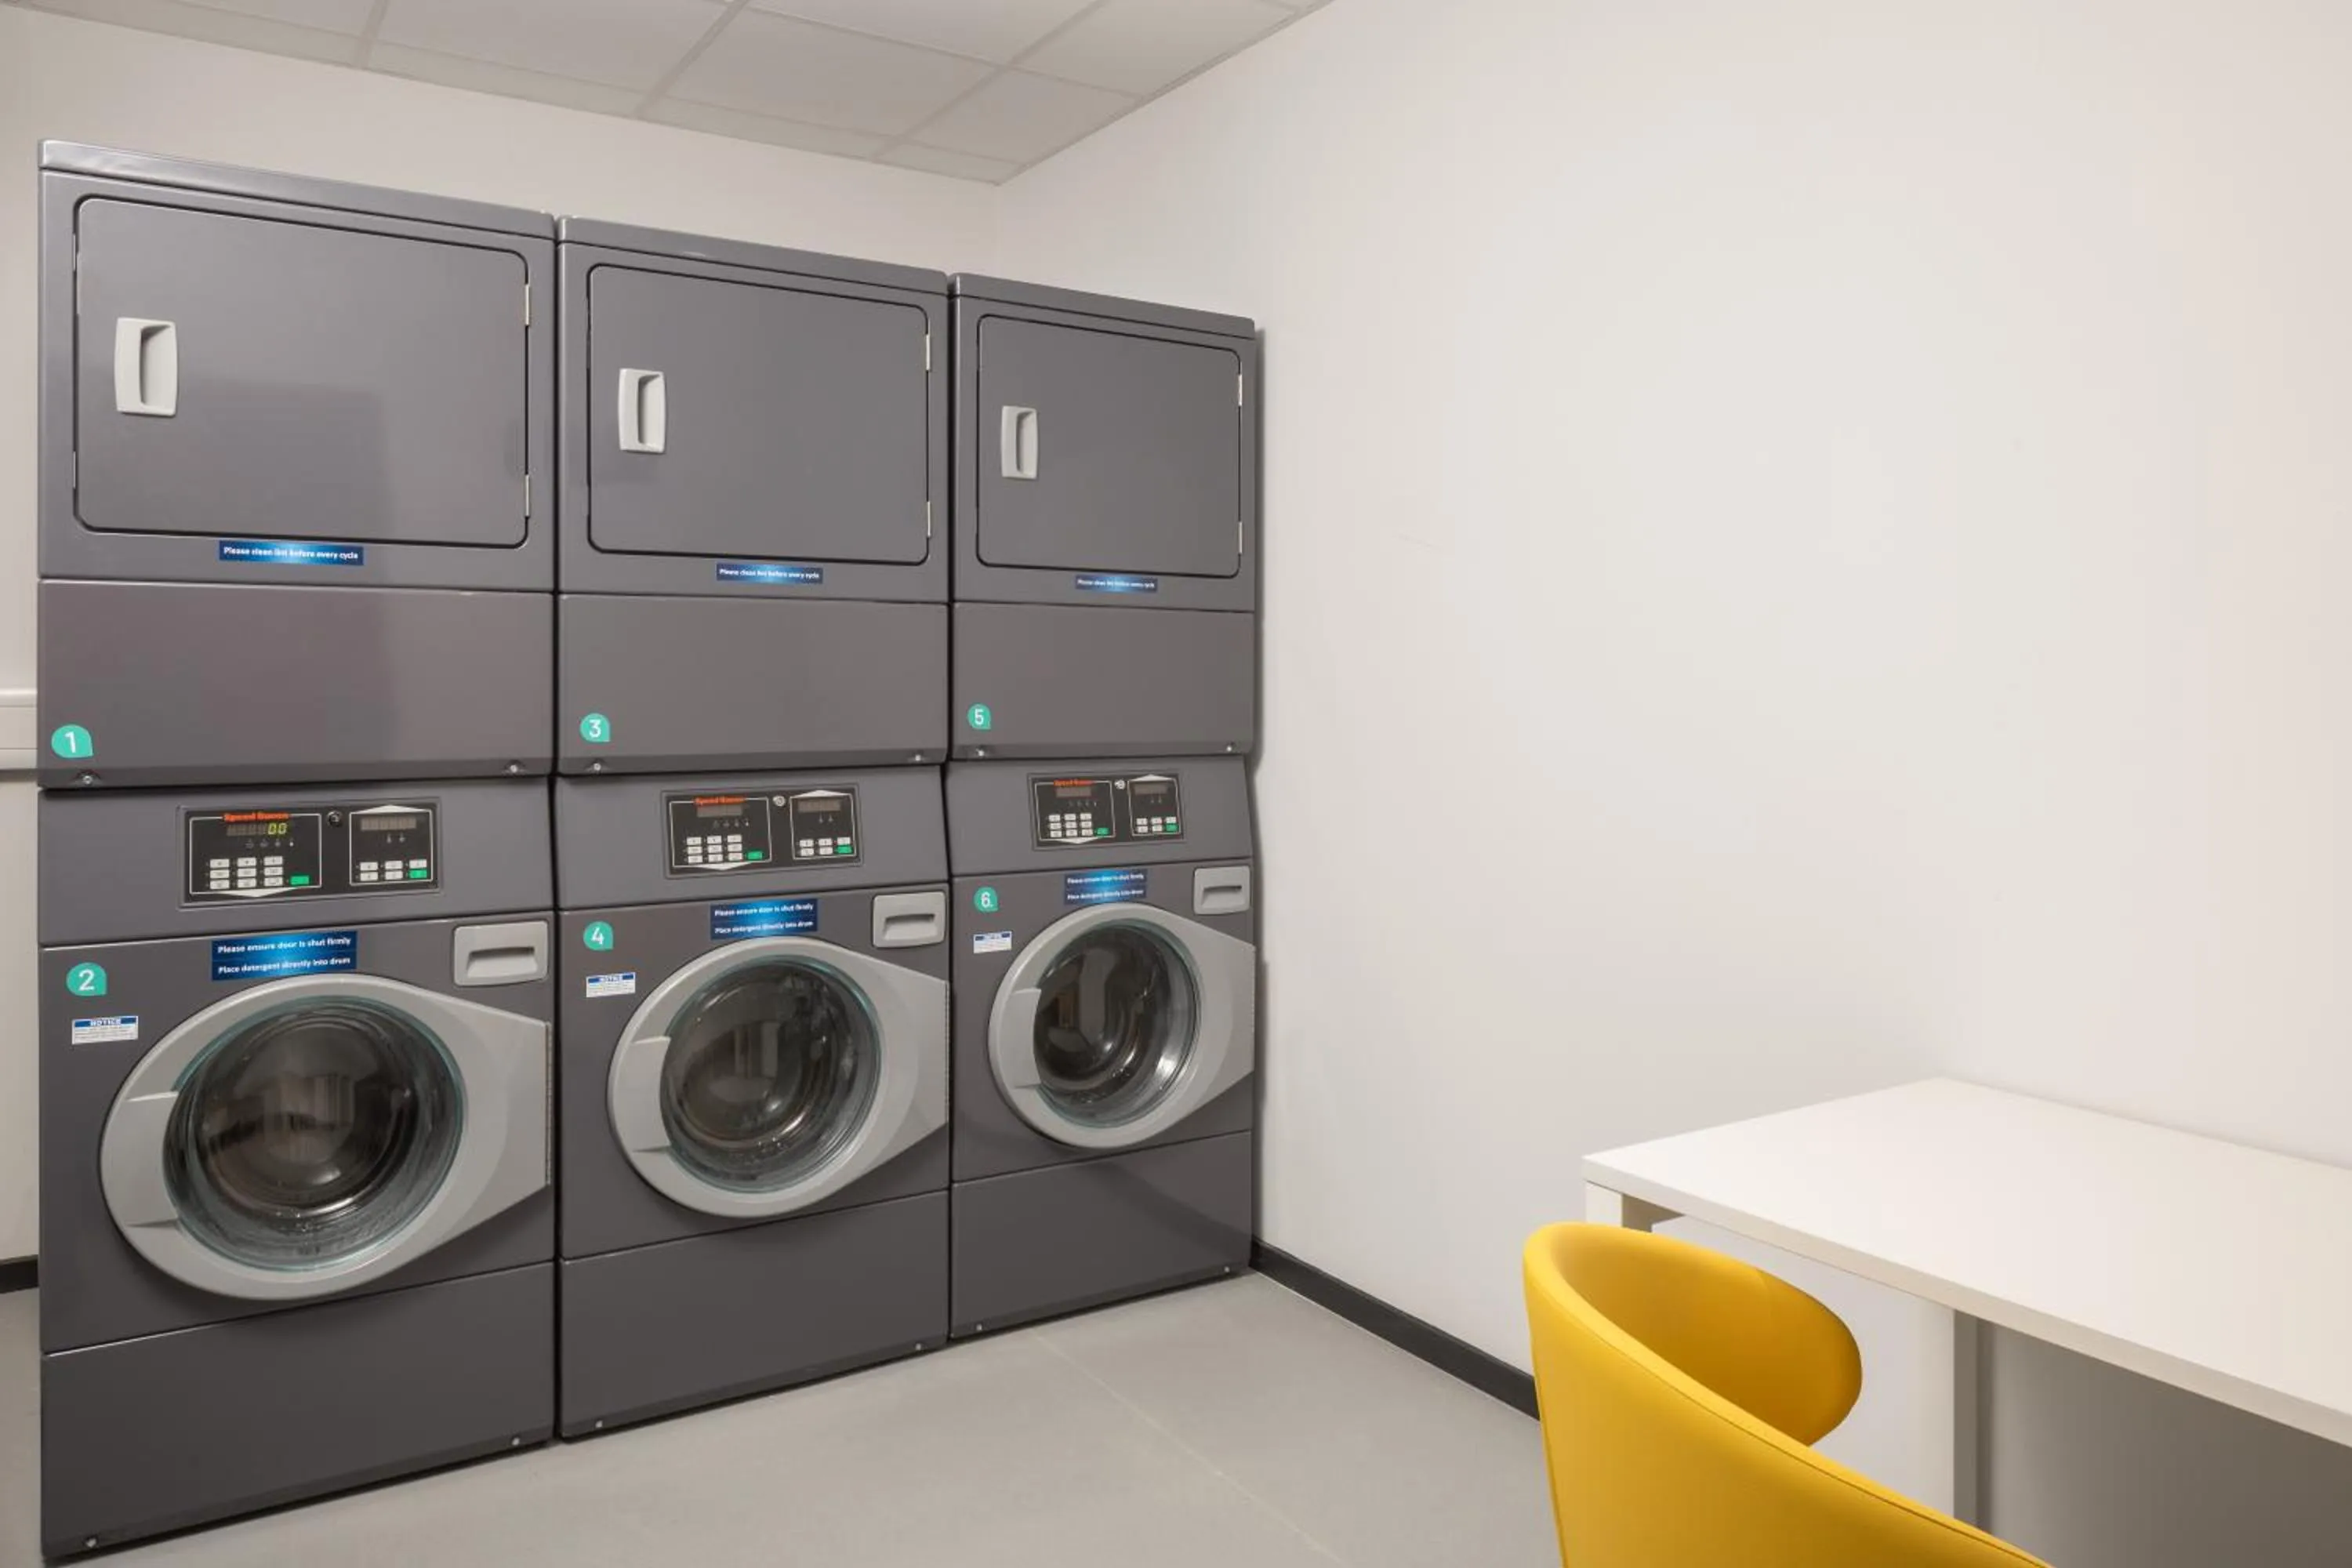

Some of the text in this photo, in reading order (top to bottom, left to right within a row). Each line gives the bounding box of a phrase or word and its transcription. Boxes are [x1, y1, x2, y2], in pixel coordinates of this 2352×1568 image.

[339, 552, 358, 561] cycle
[975, 708, 984, 725] 5
[589, 719, 601, 738] 3
[64, 731, 76, 753] 1
[224, 812, 256, 822] Speed
[591, 927, 604, 945] 4
[218, 946, 245, 954] Please
[327, 937, 351, 946] firmly
[218, 966, 240, 975] Place
[241, 963, 280, 973] detergent
[281, 960, 311, 969] directly
[314, 958, 328, 967] into
[78, 969, 95, 991] 2
